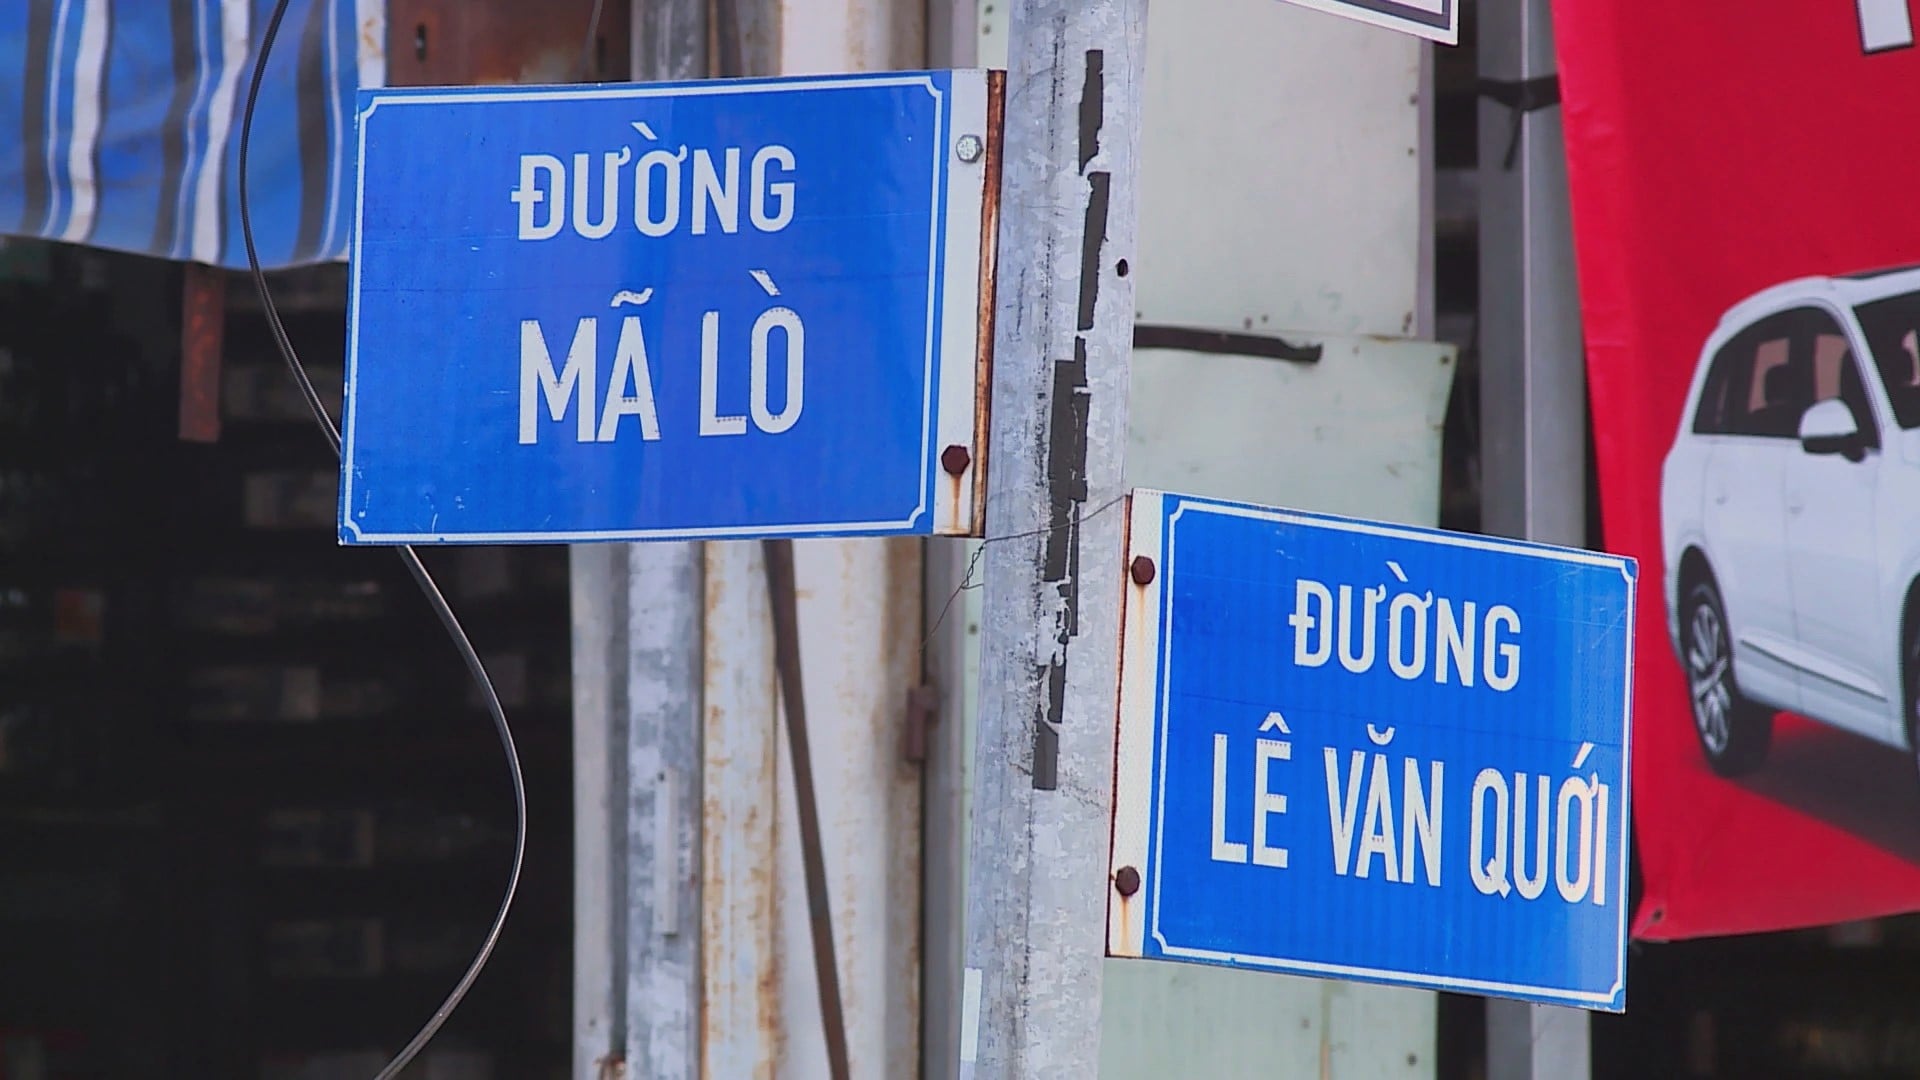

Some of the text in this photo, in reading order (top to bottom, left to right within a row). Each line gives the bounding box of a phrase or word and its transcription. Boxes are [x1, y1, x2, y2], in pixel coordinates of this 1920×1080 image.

[511, 121, 797, 240] ĐƯỜNG
[518, 269, 805, 445] MÃ LÒ
[1288, 561, 1522, 692] ĐƯỜNG
[1211, 712, 1609, 905] LÊ VĂN QUỚI
